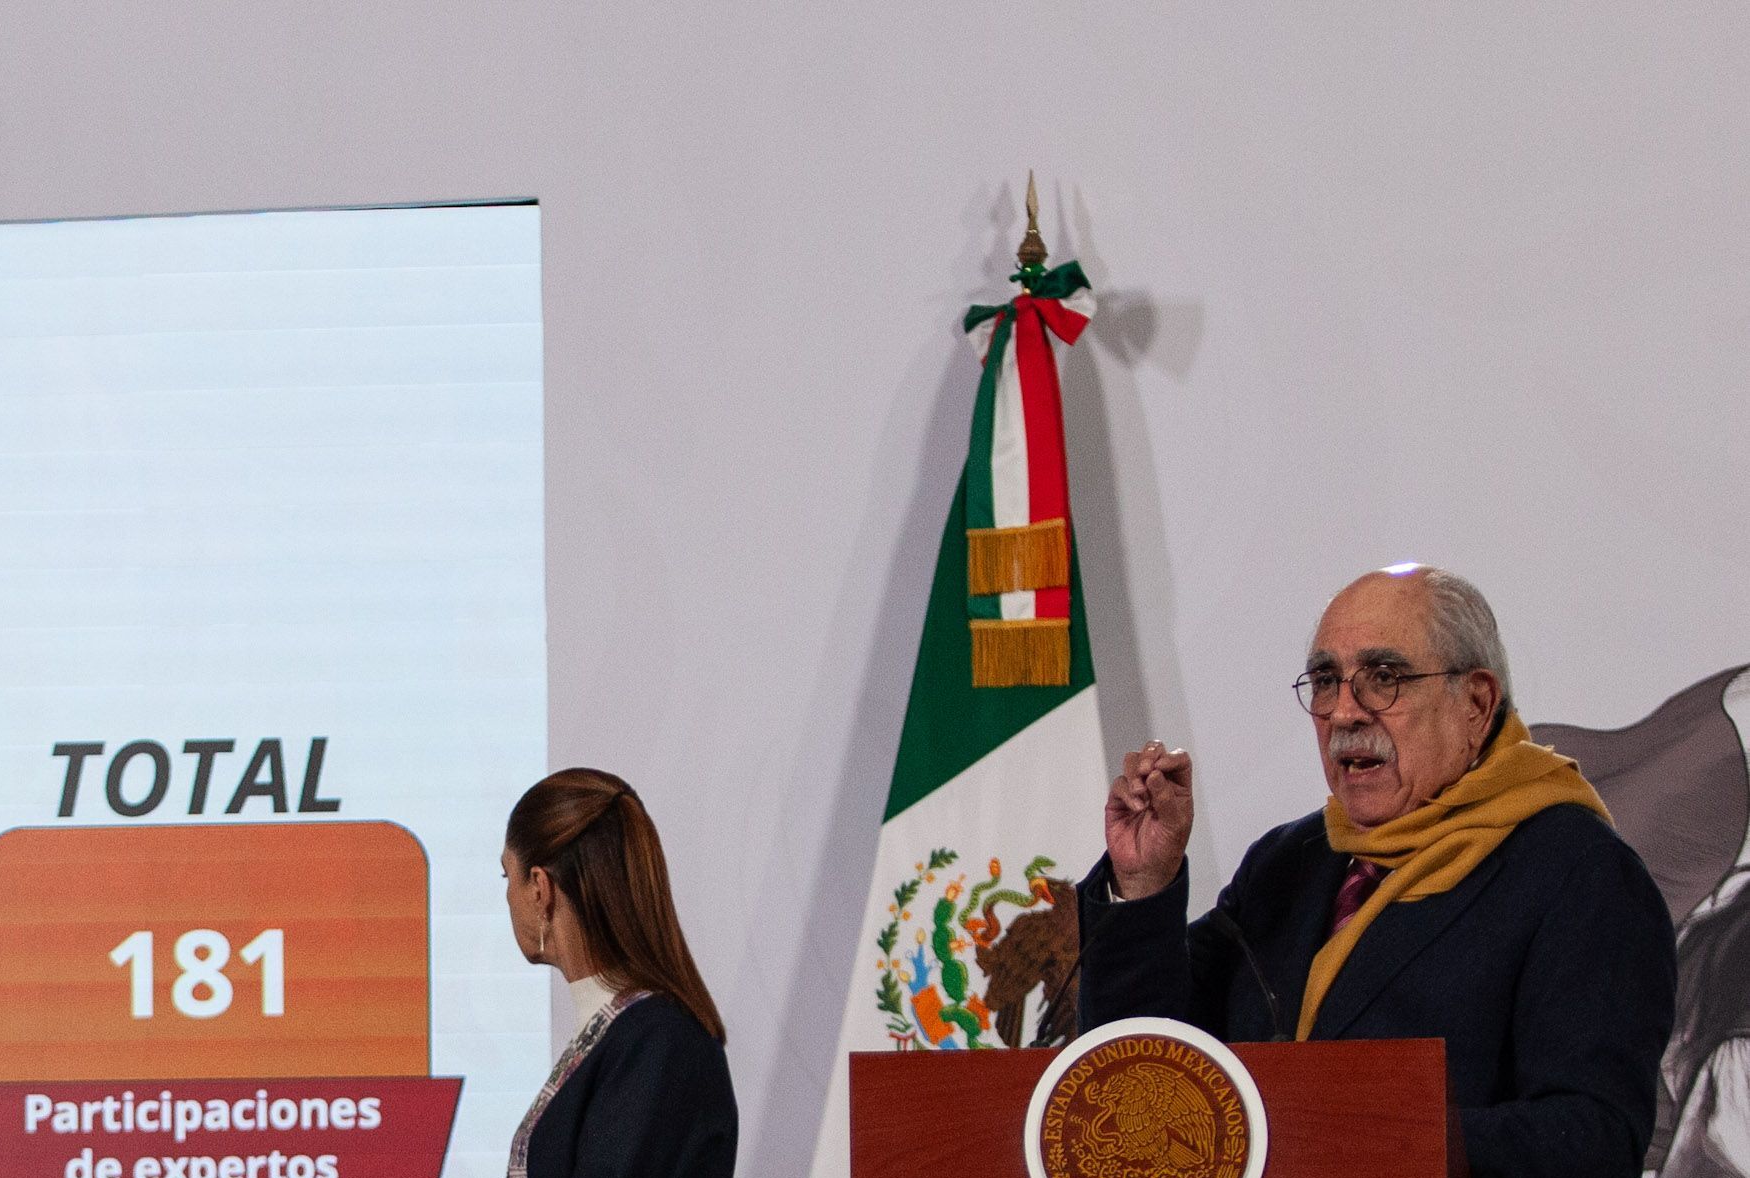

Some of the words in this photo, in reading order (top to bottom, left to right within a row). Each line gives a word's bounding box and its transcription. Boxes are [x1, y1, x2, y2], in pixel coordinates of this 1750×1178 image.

[51, 737, 342, 818] TOTAL
[108, 928, 286, 1019] 181
[24, 1089, 382, 1142] Participaciones
[1044, 1059, 1094, 1141] ESTADOS
[1095, 1039, 1164, 1069] UNIDOS
[1166, 1041, 1246, 1137] MEXICANOS
